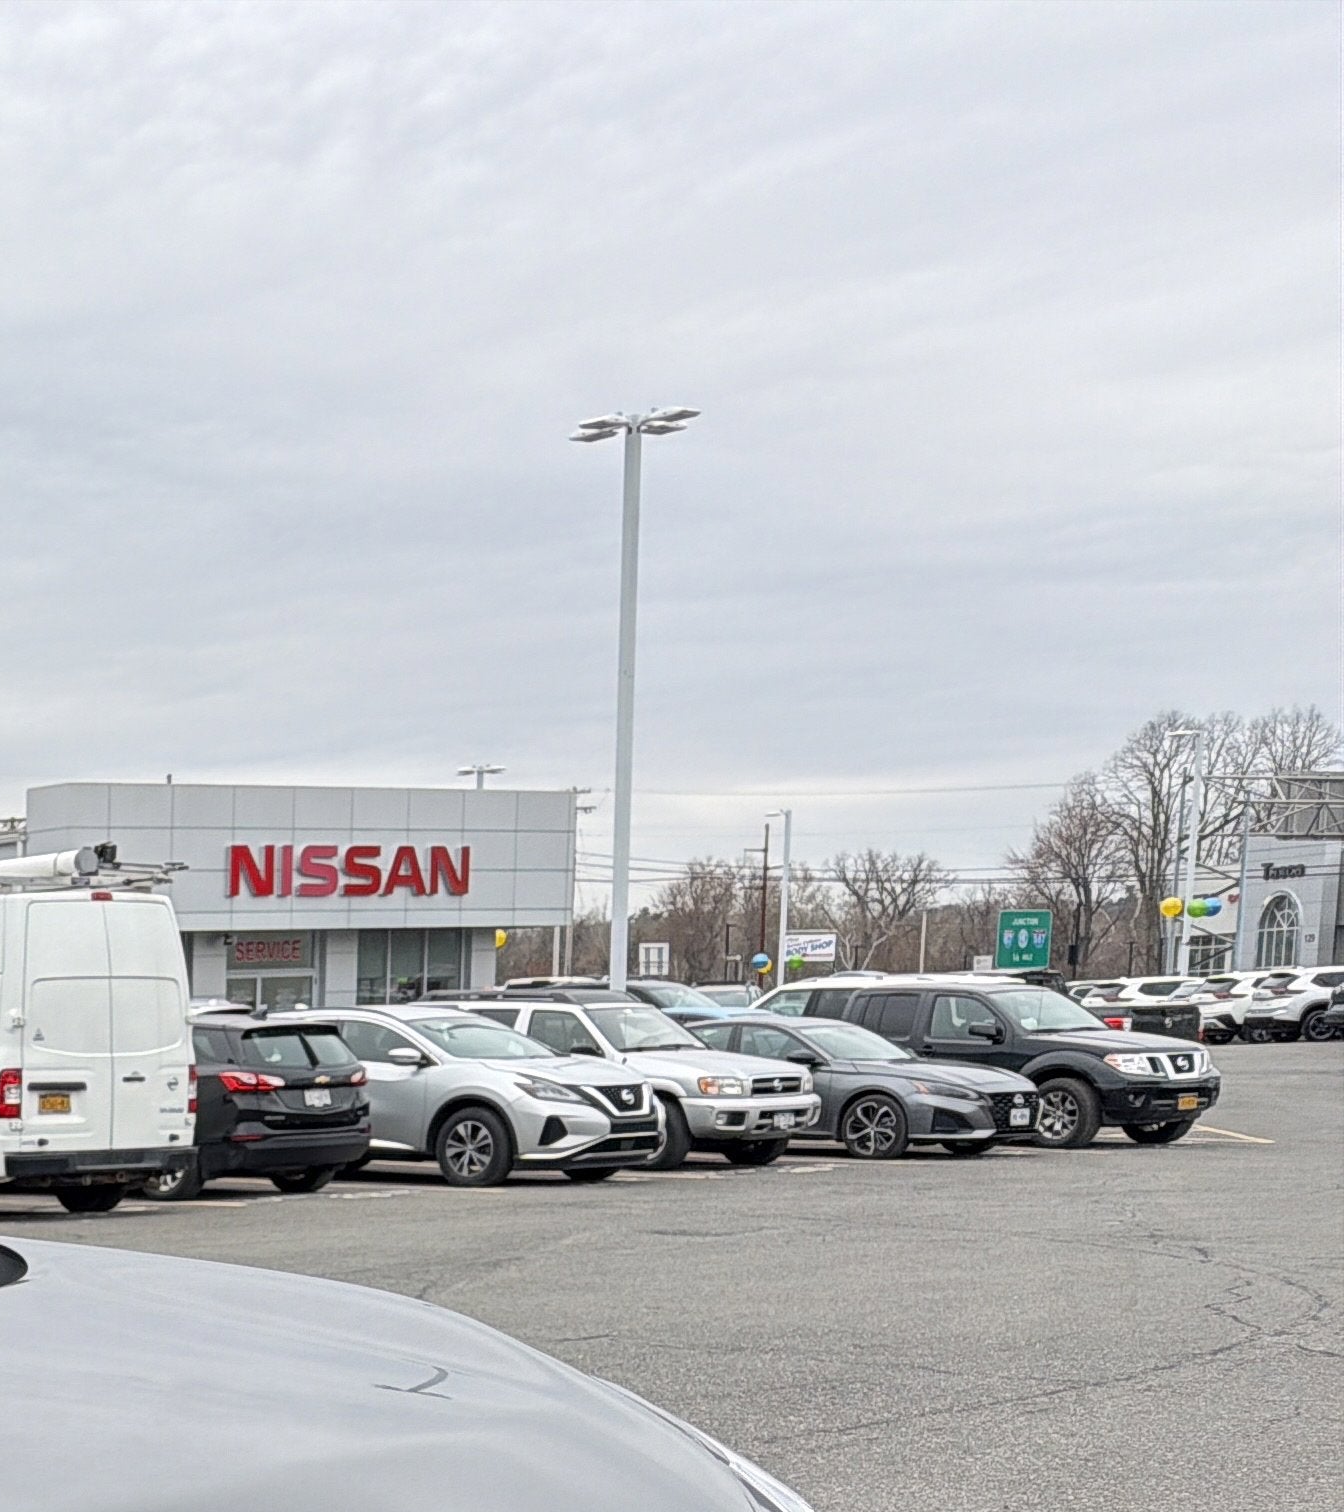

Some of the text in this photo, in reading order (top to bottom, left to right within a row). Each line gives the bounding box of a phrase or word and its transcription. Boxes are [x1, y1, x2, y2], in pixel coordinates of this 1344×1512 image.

[229, 844, 471, 898] NISSAN
[1012, 917, 1039, 926] JUNCTION
[235, 939, 302, 963] SERVICE
[810, 939, 834, 952] SHOP
